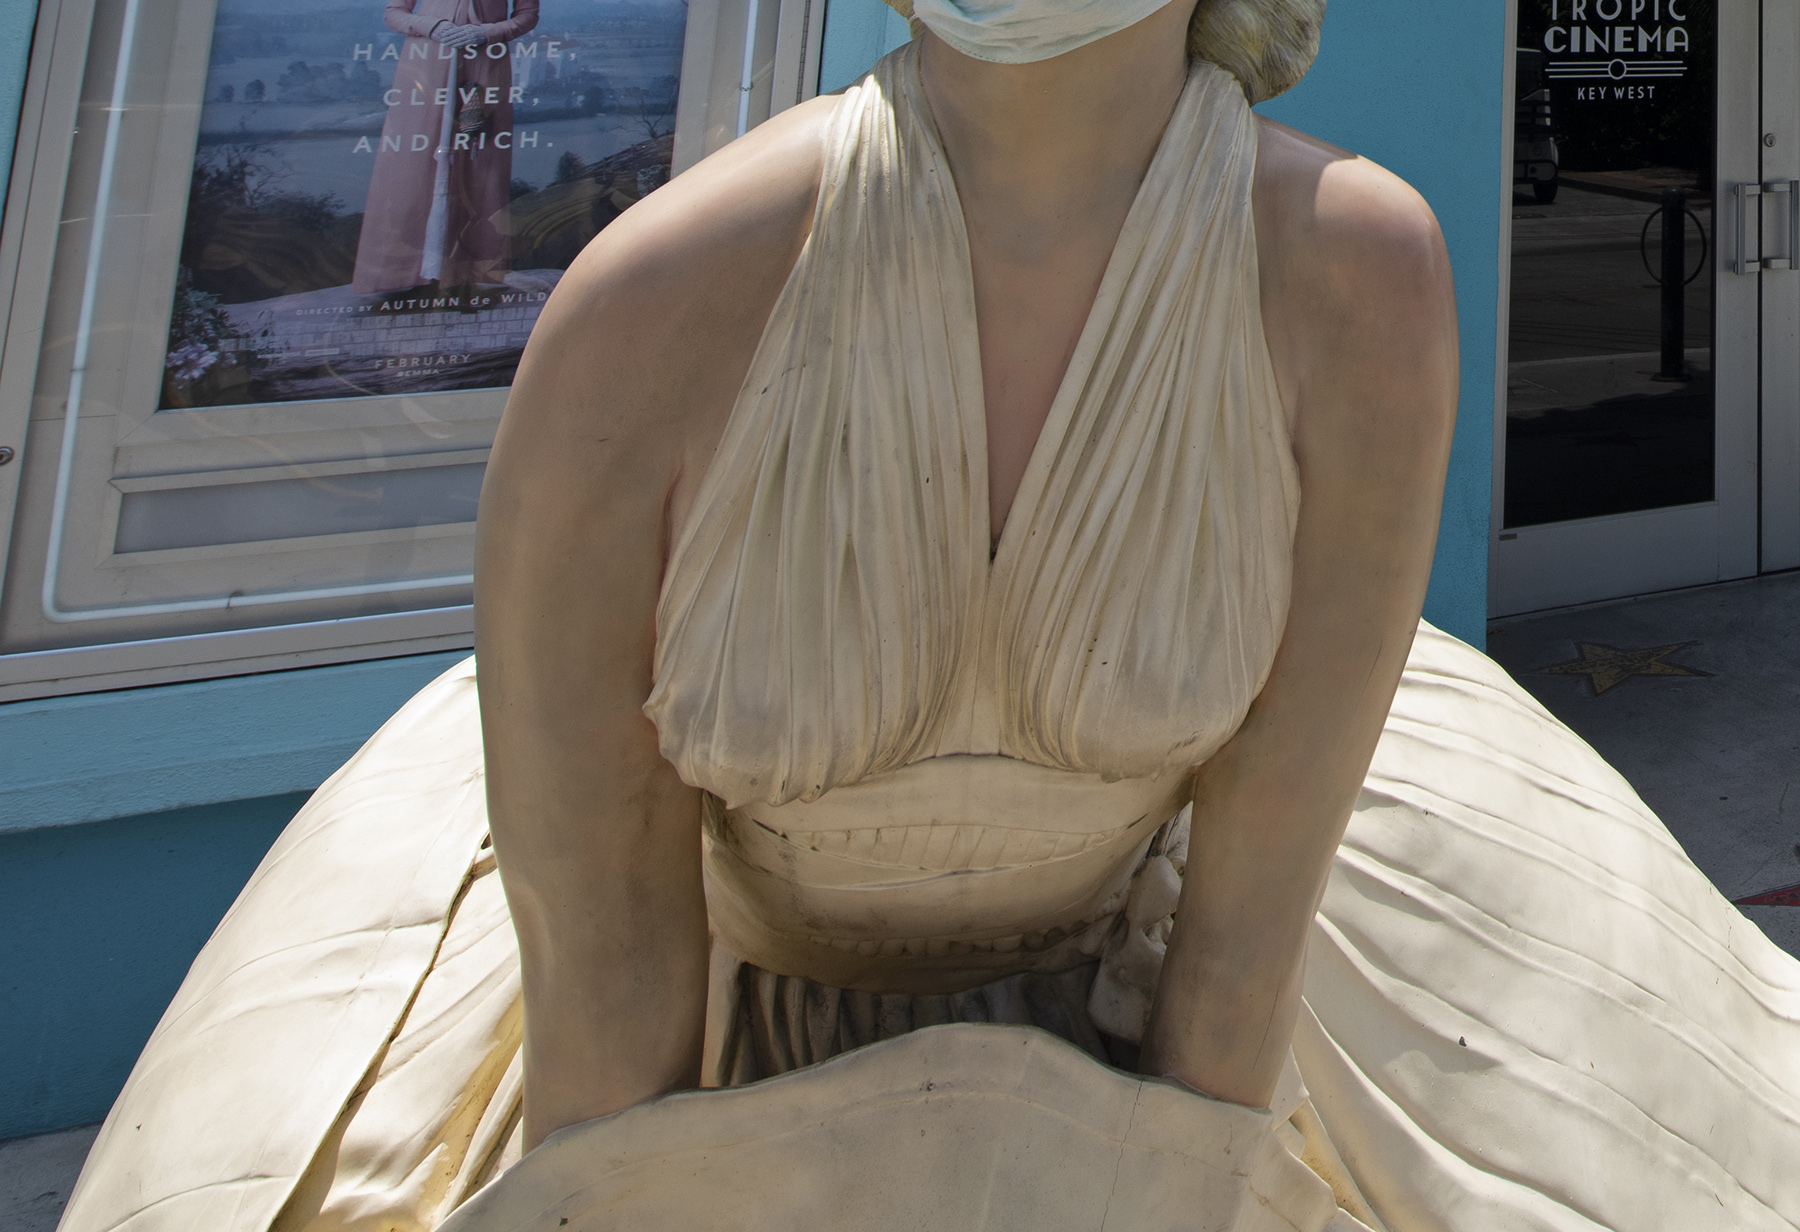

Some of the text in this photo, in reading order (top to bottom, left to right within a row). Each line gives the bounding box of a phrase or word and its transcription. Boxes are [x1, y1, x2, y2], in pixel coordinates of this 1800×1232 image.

[1544, 25, 1689, 54] CINEMA
[353, 41, 577, 62] HANDSOME,
[382, 85, 540, 108] CLEVER,
[1577, 85, 1656, 100] KEY WEST
[352, 131, 554, 154] AND RICH.
[296, 291, 548, 316] DIRECTED BY AUTUMN de WILD
[374, 353, 472, 370] FEBRUARY
